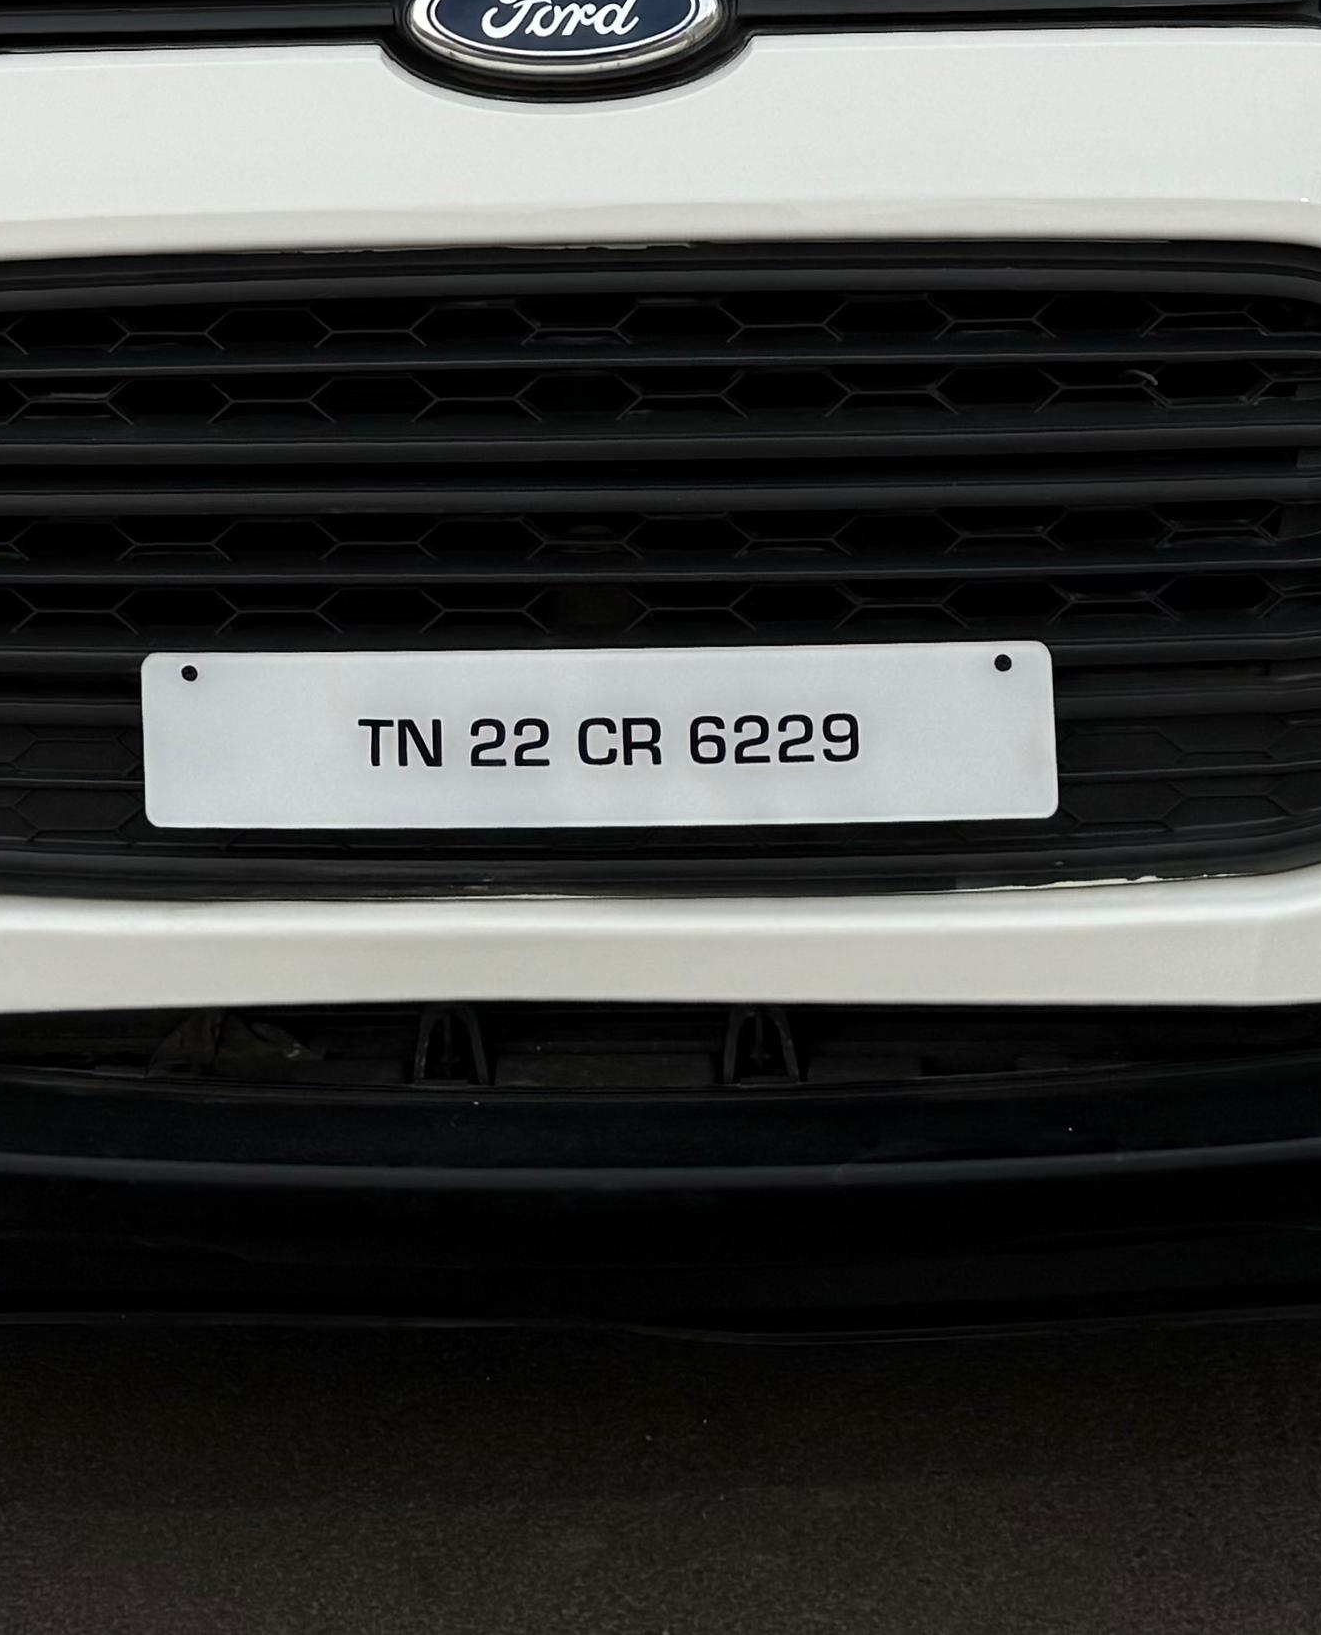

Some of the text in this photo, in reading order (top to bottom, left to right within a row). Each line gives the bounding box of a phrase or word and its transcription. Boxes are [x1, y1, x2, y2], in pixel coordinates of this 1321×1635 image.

[357, 711, 860, 768] TN 22 CR 6229
